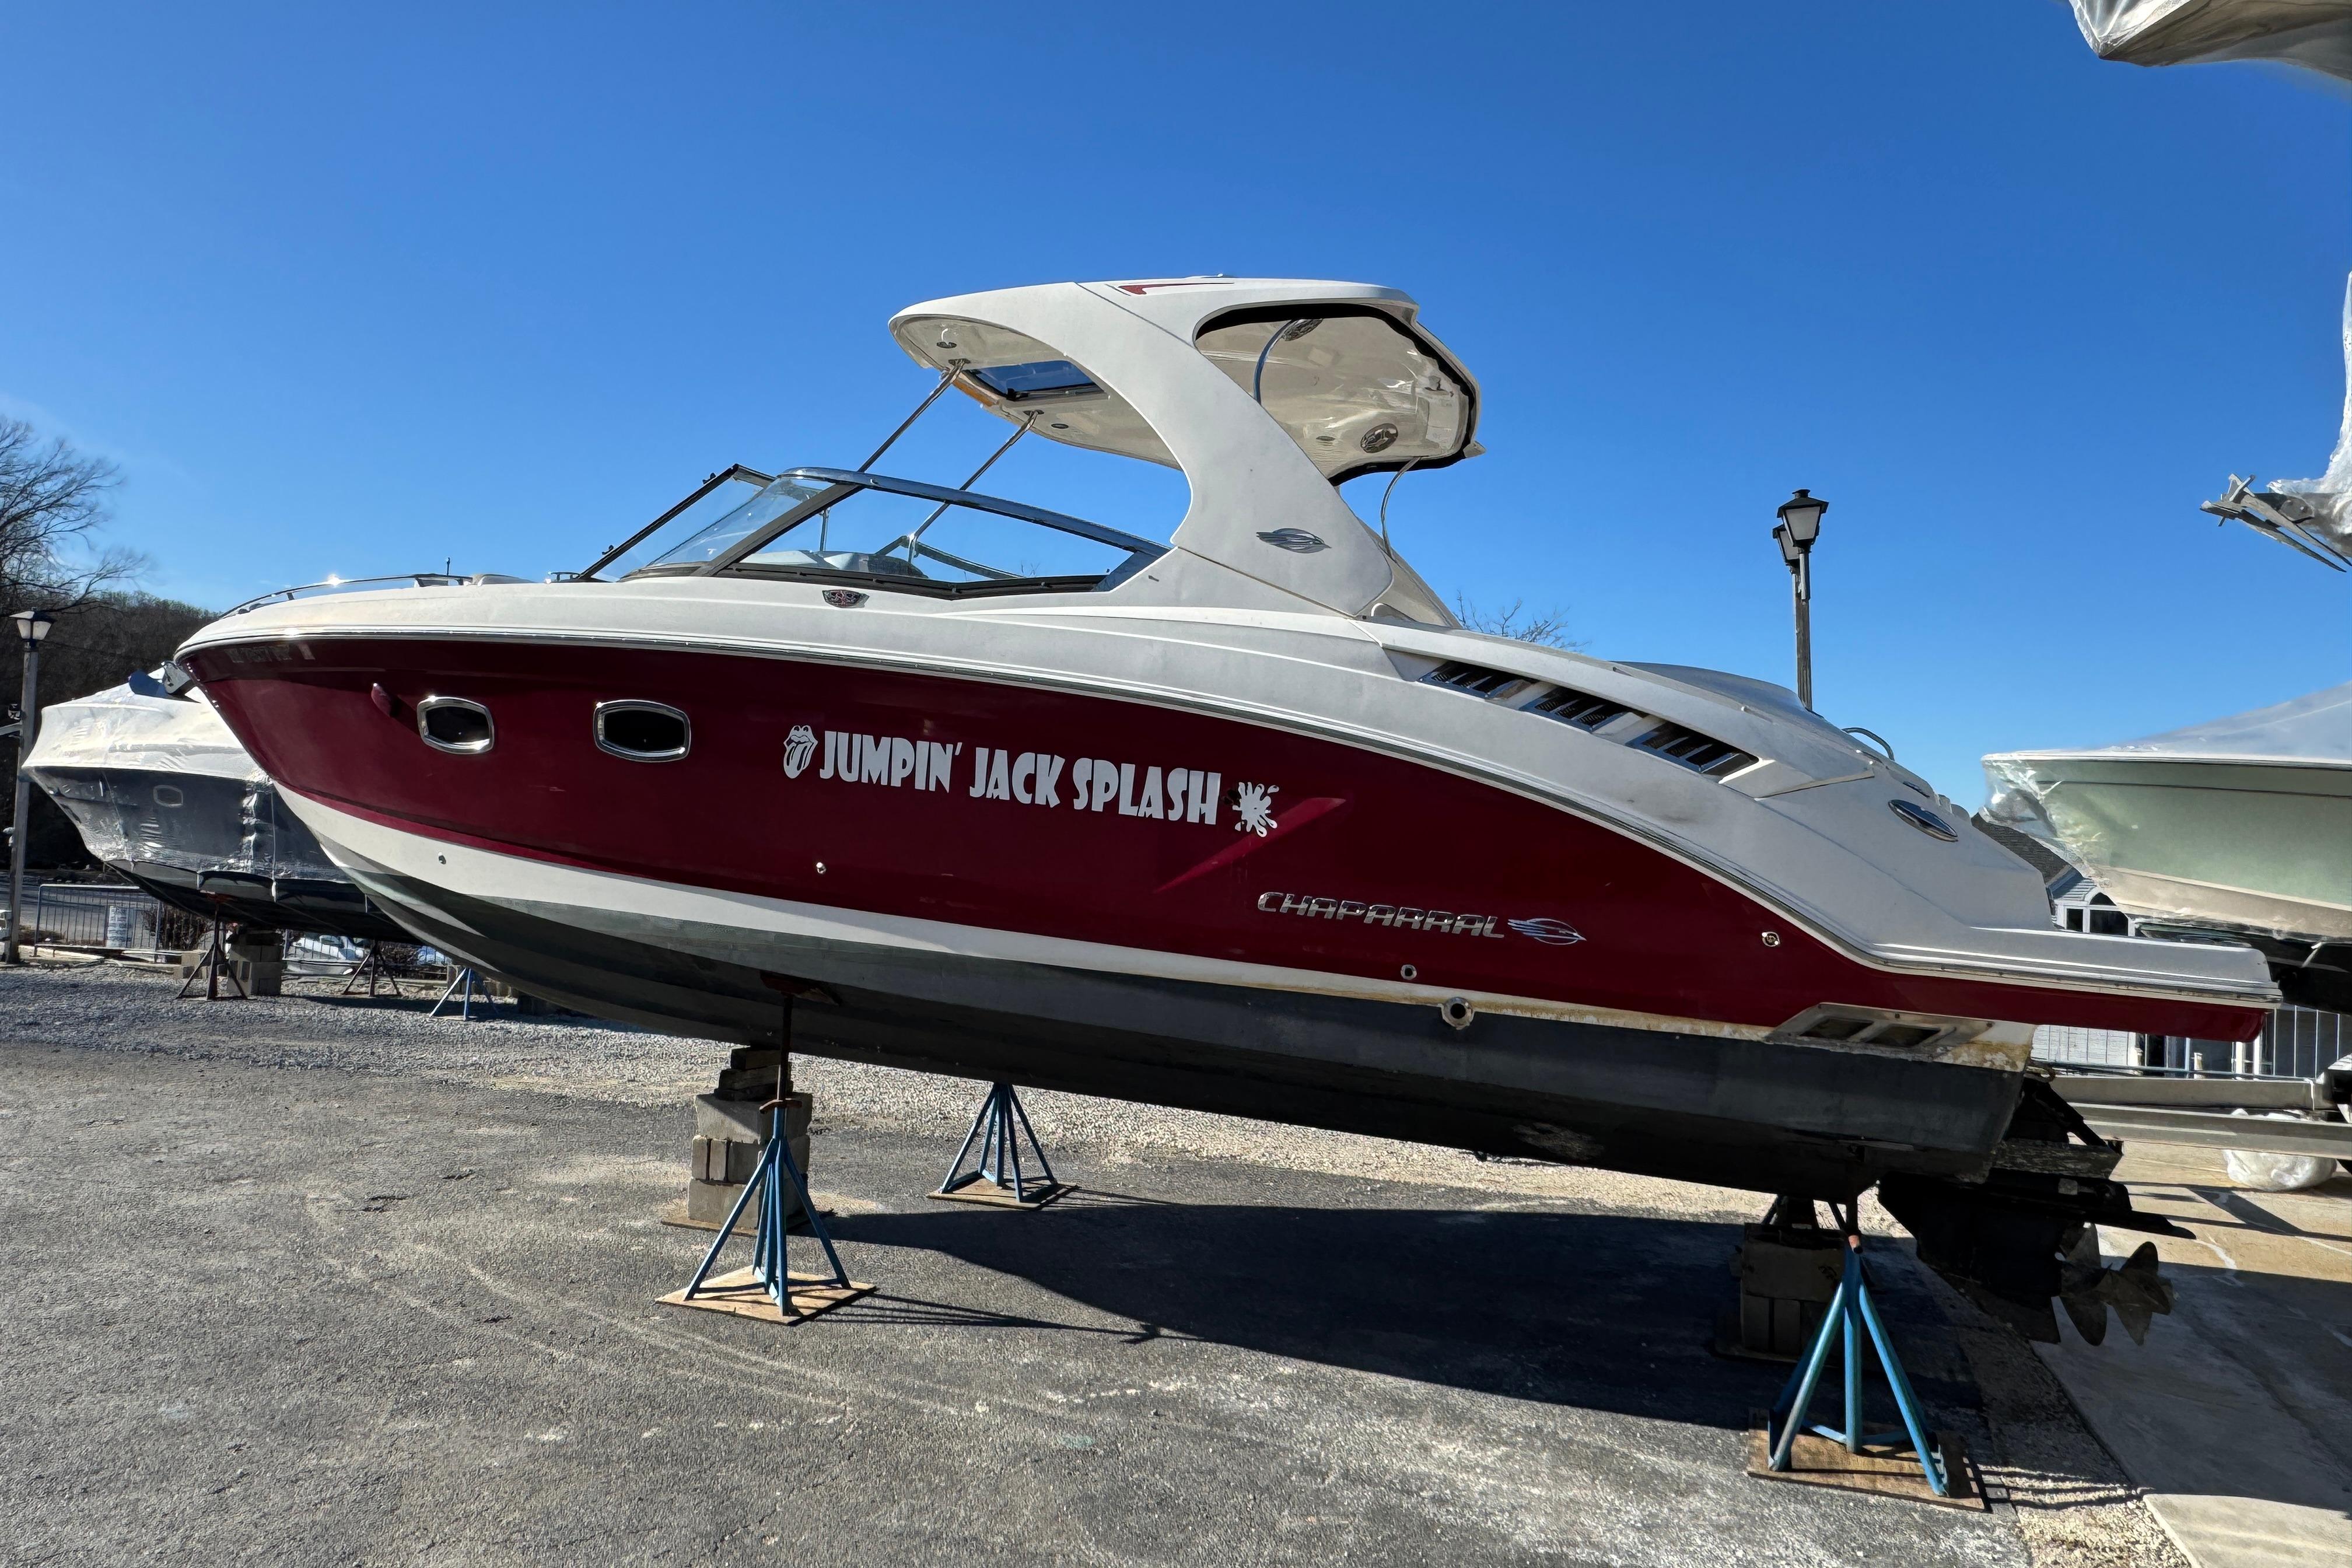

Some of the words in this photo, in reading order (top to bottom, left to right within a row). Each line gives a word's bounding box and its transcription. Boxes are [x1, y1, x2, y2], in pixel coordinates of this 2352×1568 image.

[820, 730, 963, 793] JUMPIN'
[970, 747, 1065, 808] JACK
[1072, 758, 1222, 825] SPLASH
[1258, 891, 1504, 938] CHAPARRAL
